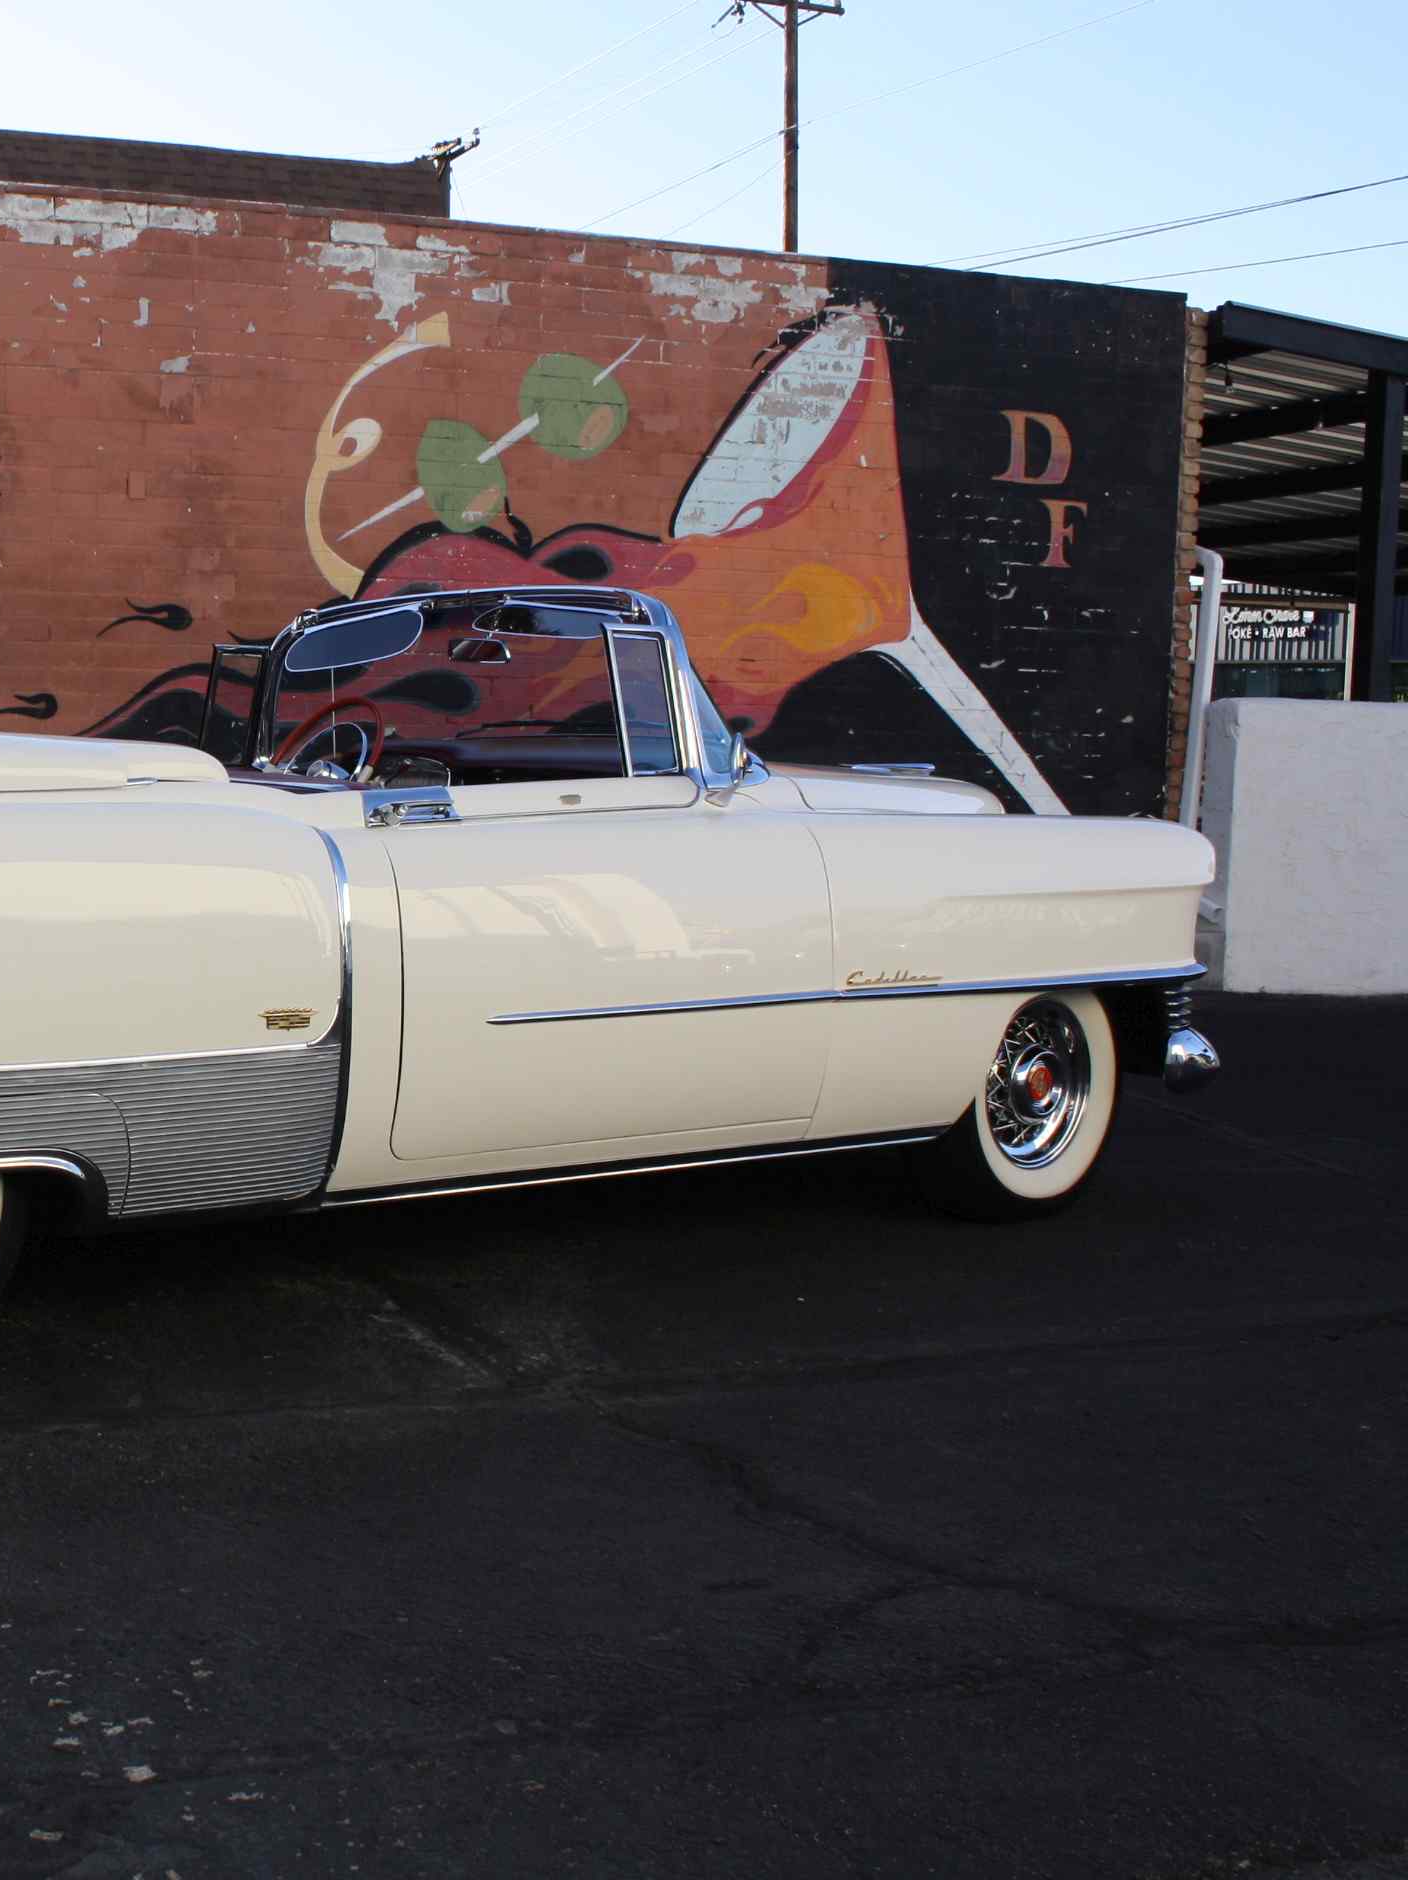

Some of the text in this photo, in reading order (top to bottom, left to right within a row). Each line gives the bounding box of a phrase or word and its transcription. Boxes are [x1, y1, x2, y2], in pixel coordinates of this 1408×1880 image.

[993, 409, 1072, 485] D
[1040, 499, 1088, 568] F
[1262, 626, 1285, 639] RAW
[1287, 626, 1306, 638] BAR
